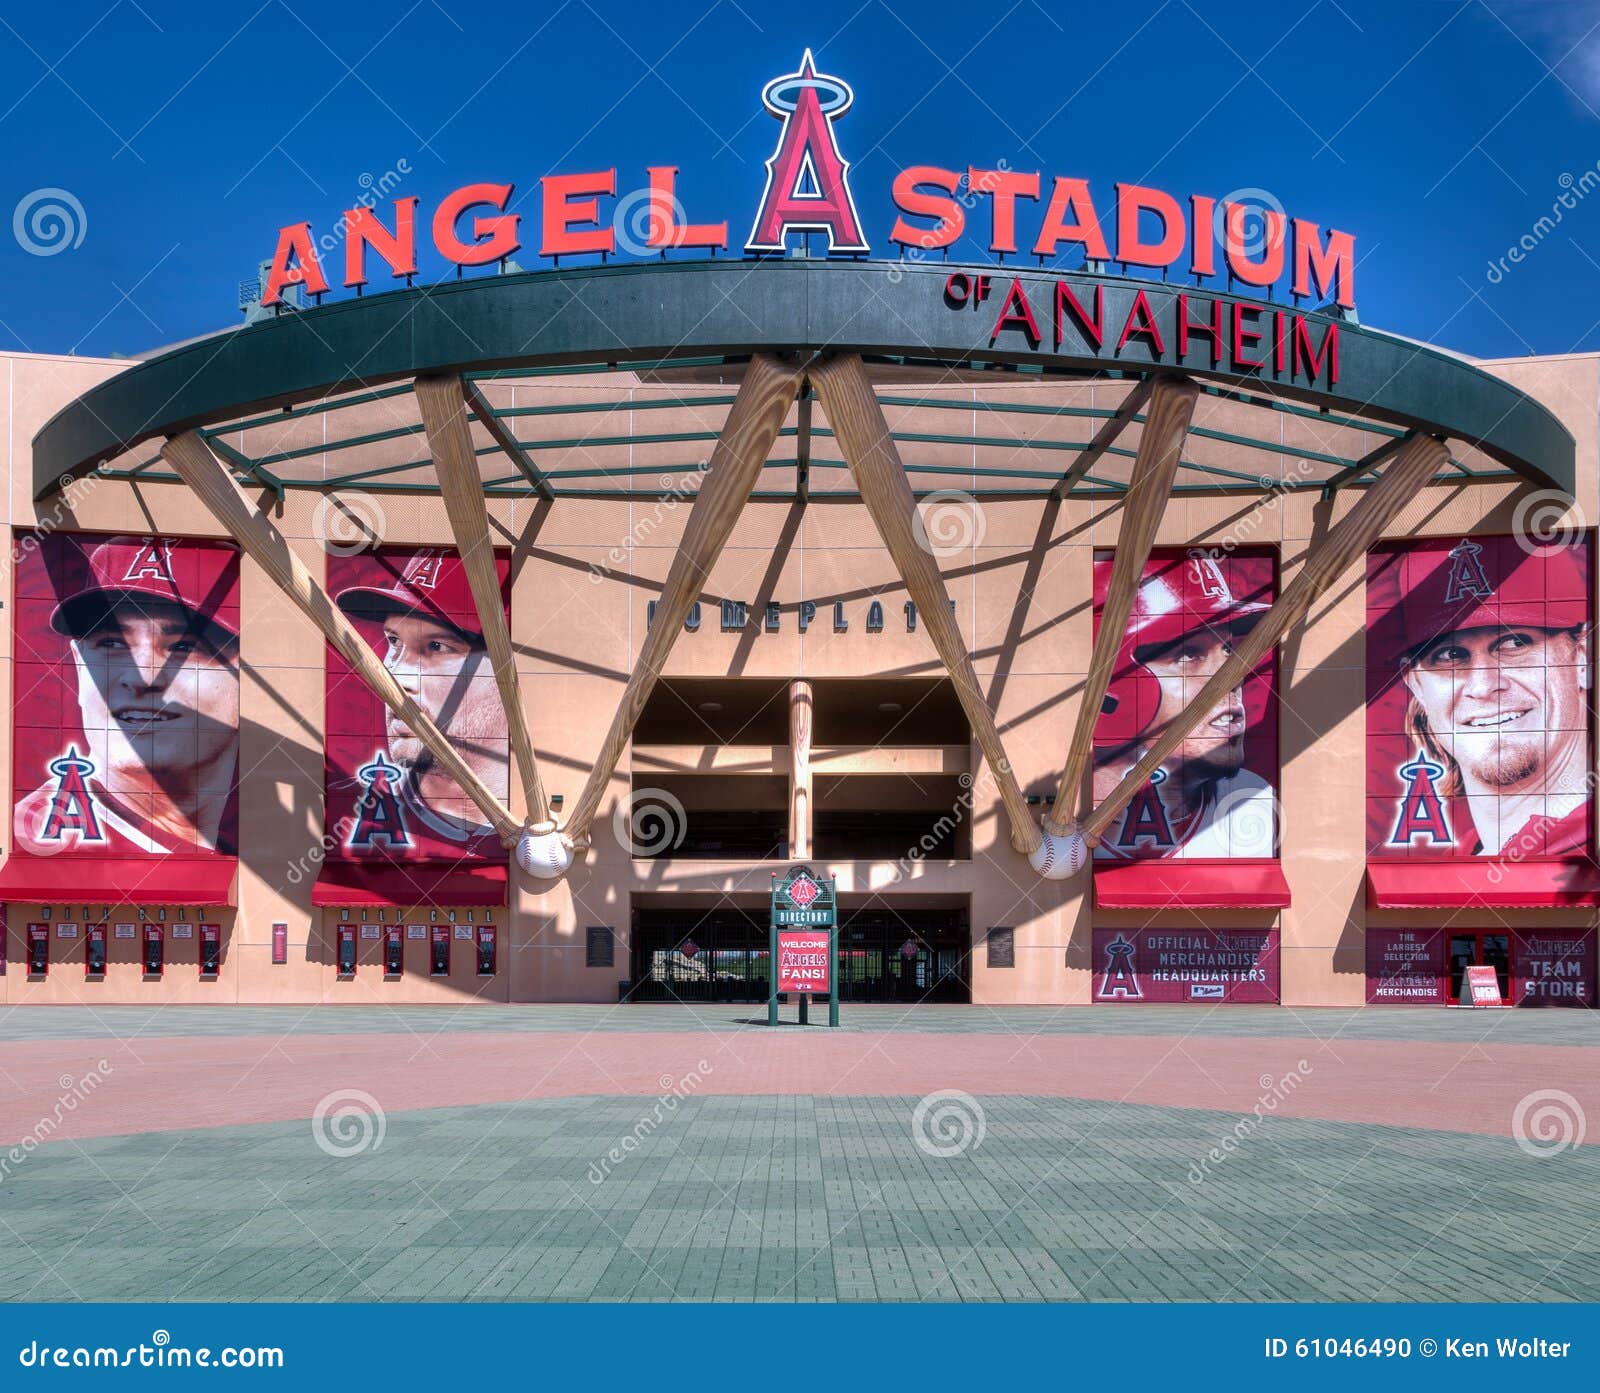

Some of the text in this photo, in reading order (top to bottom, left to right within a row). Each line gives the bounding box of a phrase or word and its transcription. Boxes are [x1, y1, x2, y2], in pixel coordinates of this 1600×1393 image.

[744, 47, 869, 254] A
[260, 166, 728, 308] ANGEL
[889, 164, 1356, 309] STADIUM
[946, 271, 1340, 385] OF ANAHEIM
[122, 537, 177, 582] A
[406, 548, 444, 589] A
[1444, 539, 1493, 603] A
[647, 600, 956, 633] OMEPLAT
[40, 744, 105, 843] A
[348, 751, 414, 847] A
[1388, 749, 1457, 846] A
[1116, 765, 1176, 847] A
[341, 908, 492, 922] WILL CALL
[780, 911, 828, 922] DIRECTORY
[780, 941, 827, 949] WELCOME
[1147, 936, 1210, 949] OFFICIAL
[1399, 933, 1415, 942] THE
[1387, 943, 1426, 951] LARGEST
[782, 949, 827, 967] ANGELS
[1098, 934, 1144, 998] A
[1159, 953, 1259, 966] MERCHANDISE
[1383, 953, 1430, 961] SELECTION
[782, 969, 825, 979] FANS!
[1152, 969, 1267, 982] HEADQUARTERS
[1530, 961, 1581, 977] TEAM
[1376, 988, 1438, 997] MERCHANDISE
[1525, 981, 1586, 997] STORE
